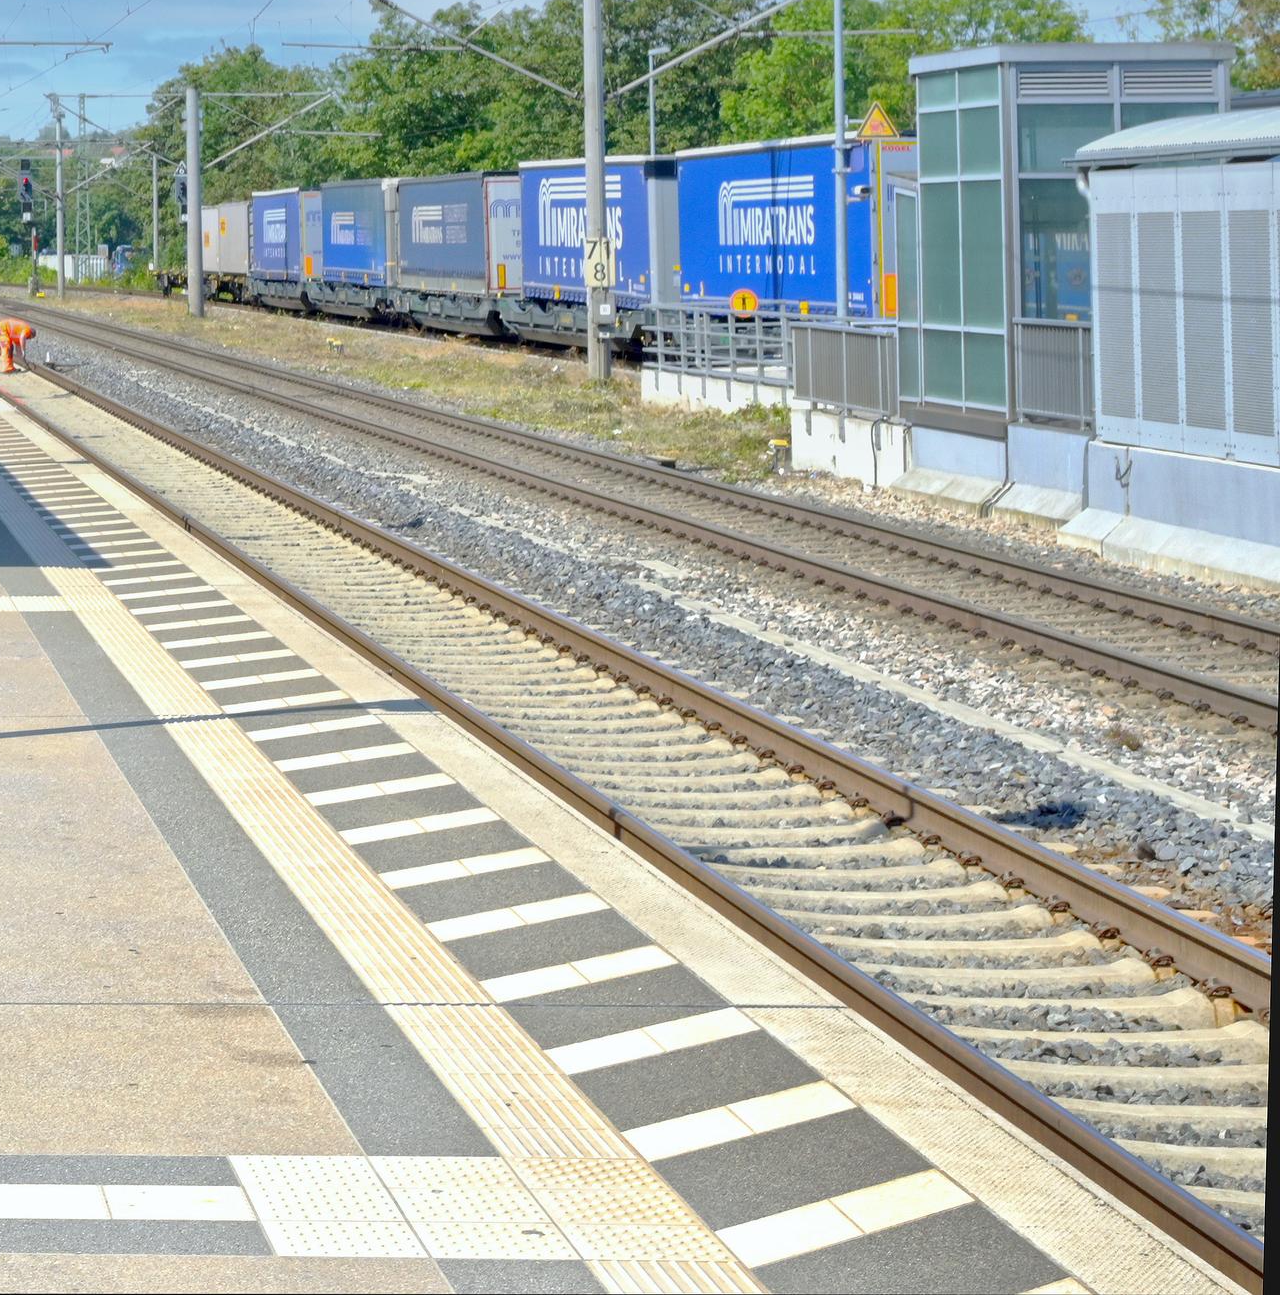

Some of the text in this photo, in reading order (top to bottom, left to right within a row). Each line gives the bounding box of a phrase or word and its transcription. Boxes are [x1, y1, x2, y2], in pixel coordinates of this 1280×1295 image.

[558, 206, 623, 250] MIRANS
[740, 205, 814, 245] MIRATRANS
[587, 241, 610, 260] 71
[594, 263, 606, 281] 8
[720, 255, 815, 275] INTERMODAL
